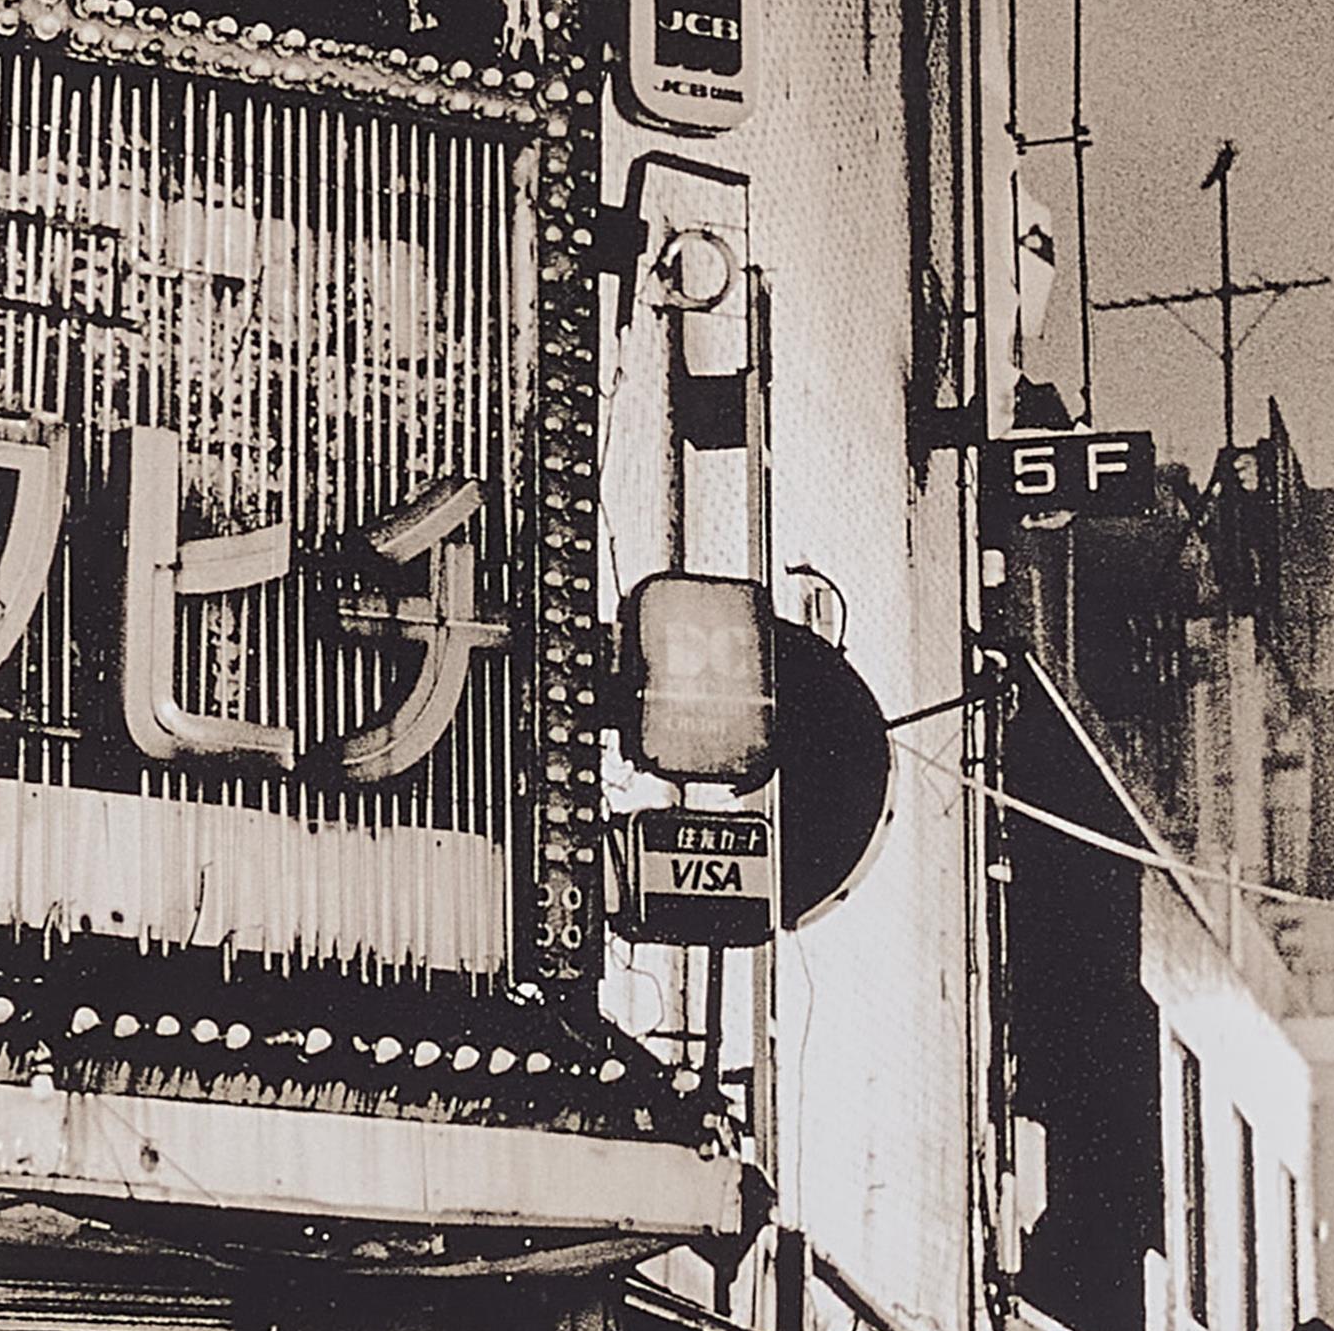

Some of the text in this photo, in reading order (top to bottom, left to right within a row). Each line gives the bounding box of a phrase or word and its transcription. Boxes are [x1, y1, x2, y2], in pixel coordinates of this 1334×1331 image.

[659, 10, 739, 40] JCB
[654, 79, 707, 98] JCB
[671, 859, 742, 891] VISA
